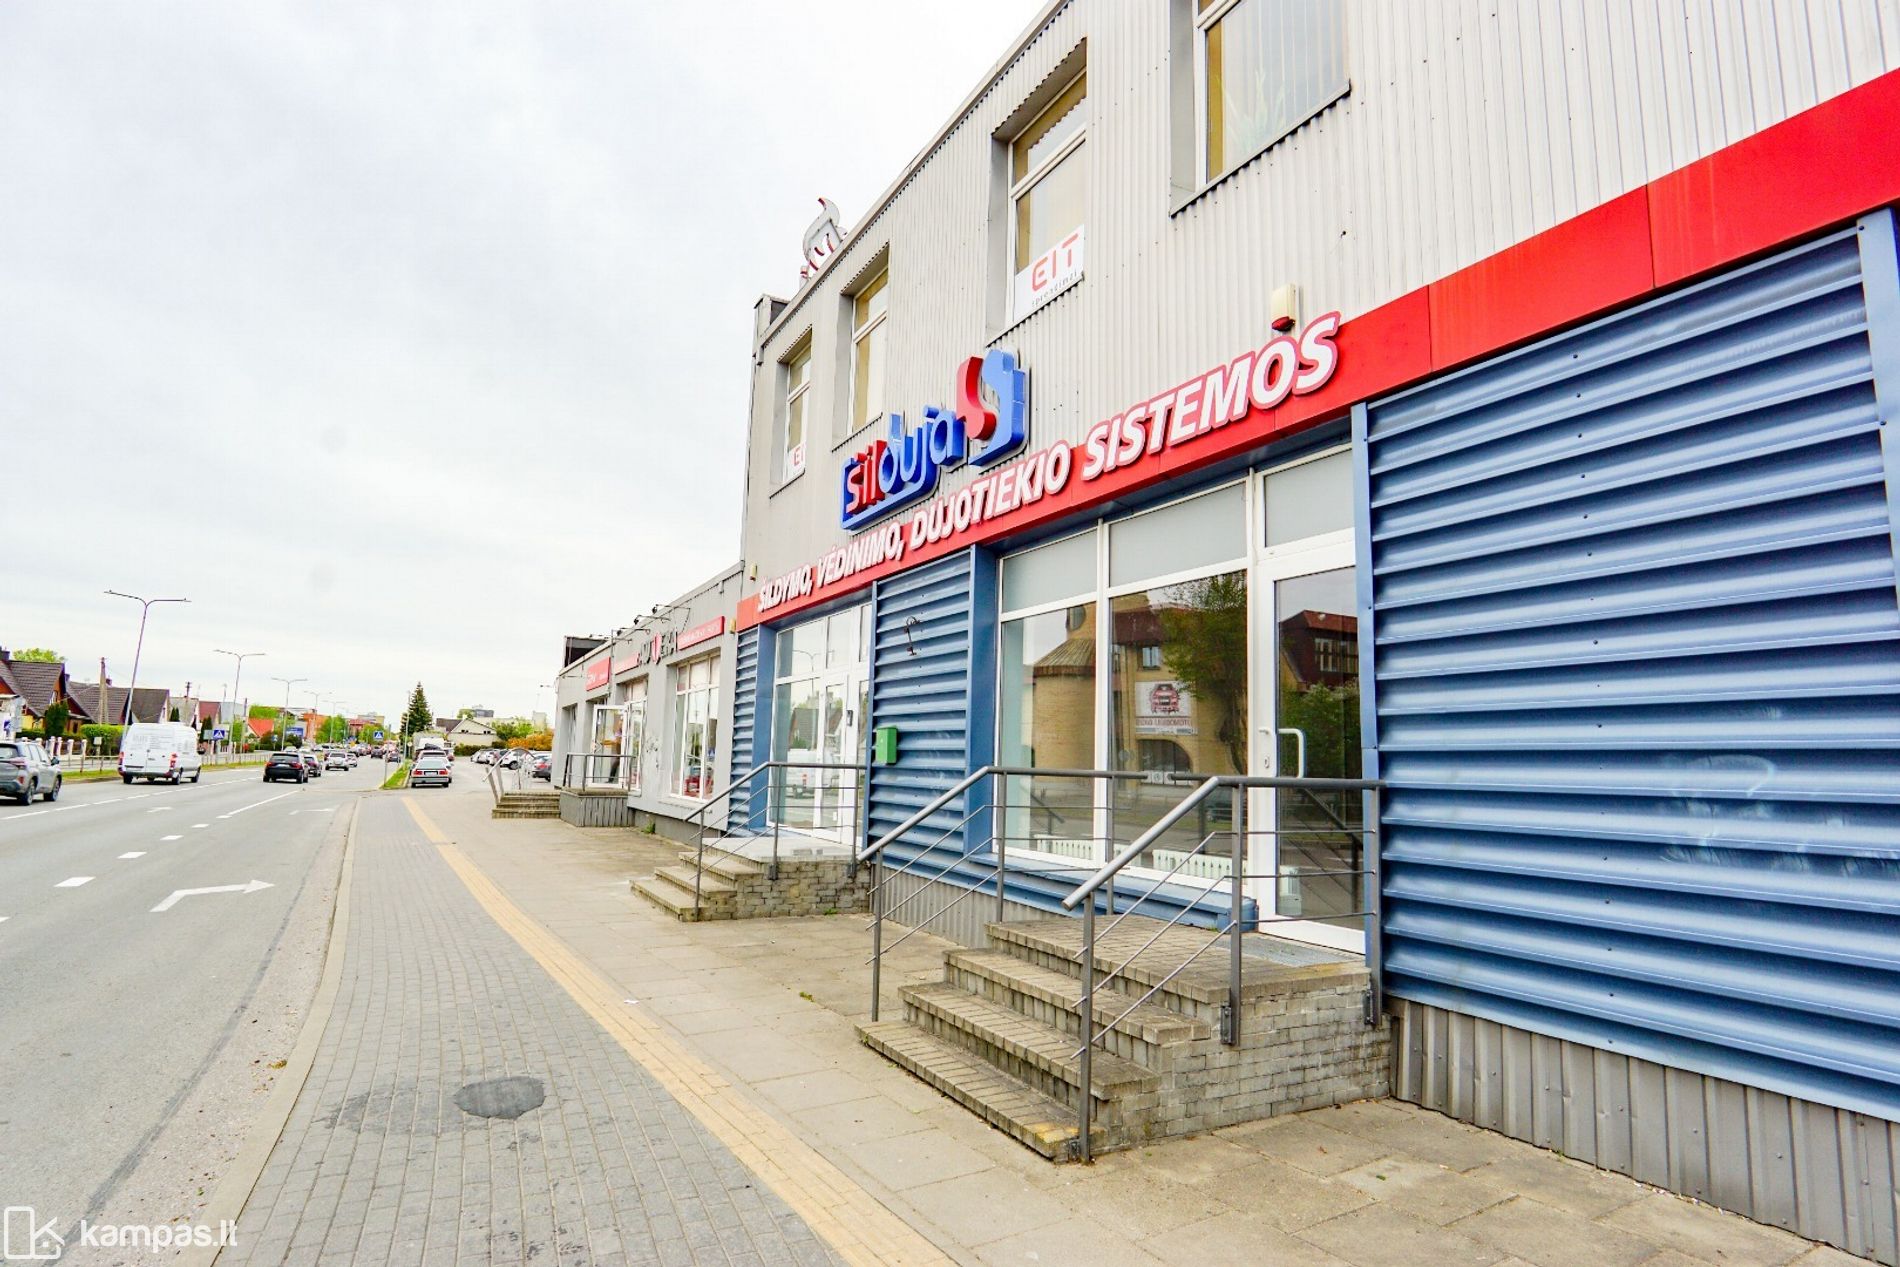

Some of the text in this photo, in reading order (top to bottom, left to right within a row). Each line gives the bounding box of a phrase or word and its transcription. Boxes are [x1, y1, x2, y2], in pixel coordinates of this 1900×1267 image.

[1031, 232, 1079, 292] EIT
[909, 439, 1071, 551] DUJOTIEKIO
[1081, 310, 1342, 481] SISTEMOS
